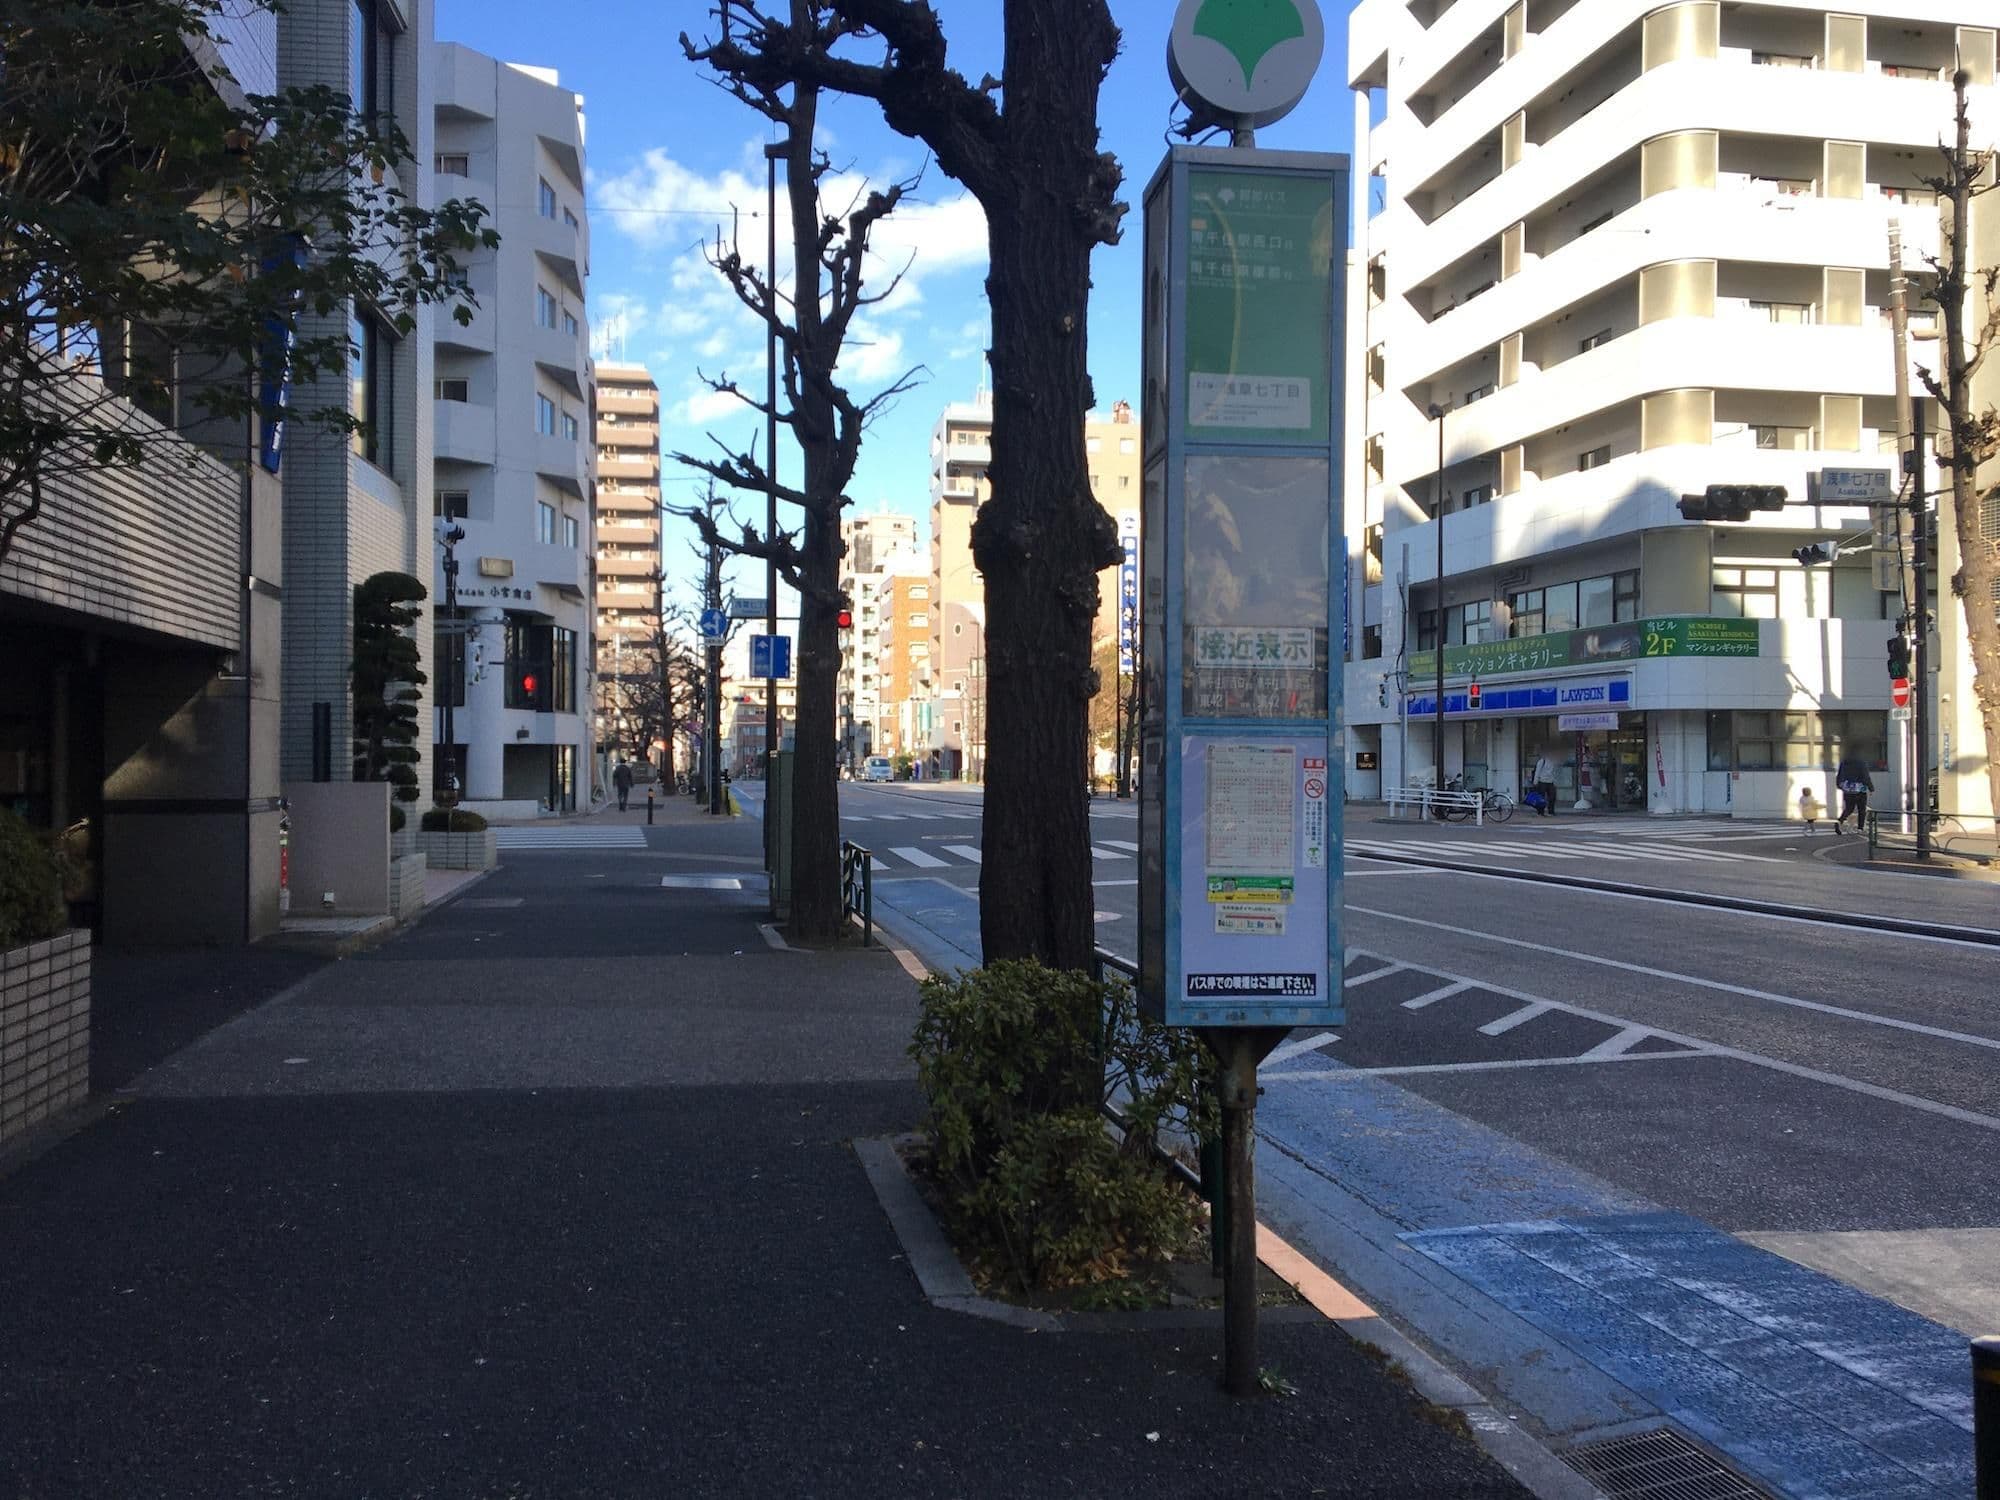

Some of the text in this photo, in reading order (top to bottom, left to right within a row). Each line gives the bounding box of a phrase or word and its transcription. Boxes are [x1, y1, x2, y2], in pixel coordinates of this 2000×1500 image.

[1826, 472, 1886, 487] 浅草七丁目
[1200, 630, 1308, 661] 接近表示
[1646, 633, 1677, 656] 2F
[1686, 643, 1757, 653] マンションギャラリー
[1456, 648, 1564, 673] マンションギャラリー
[1561, 686, 1605, 702] LAWSON
